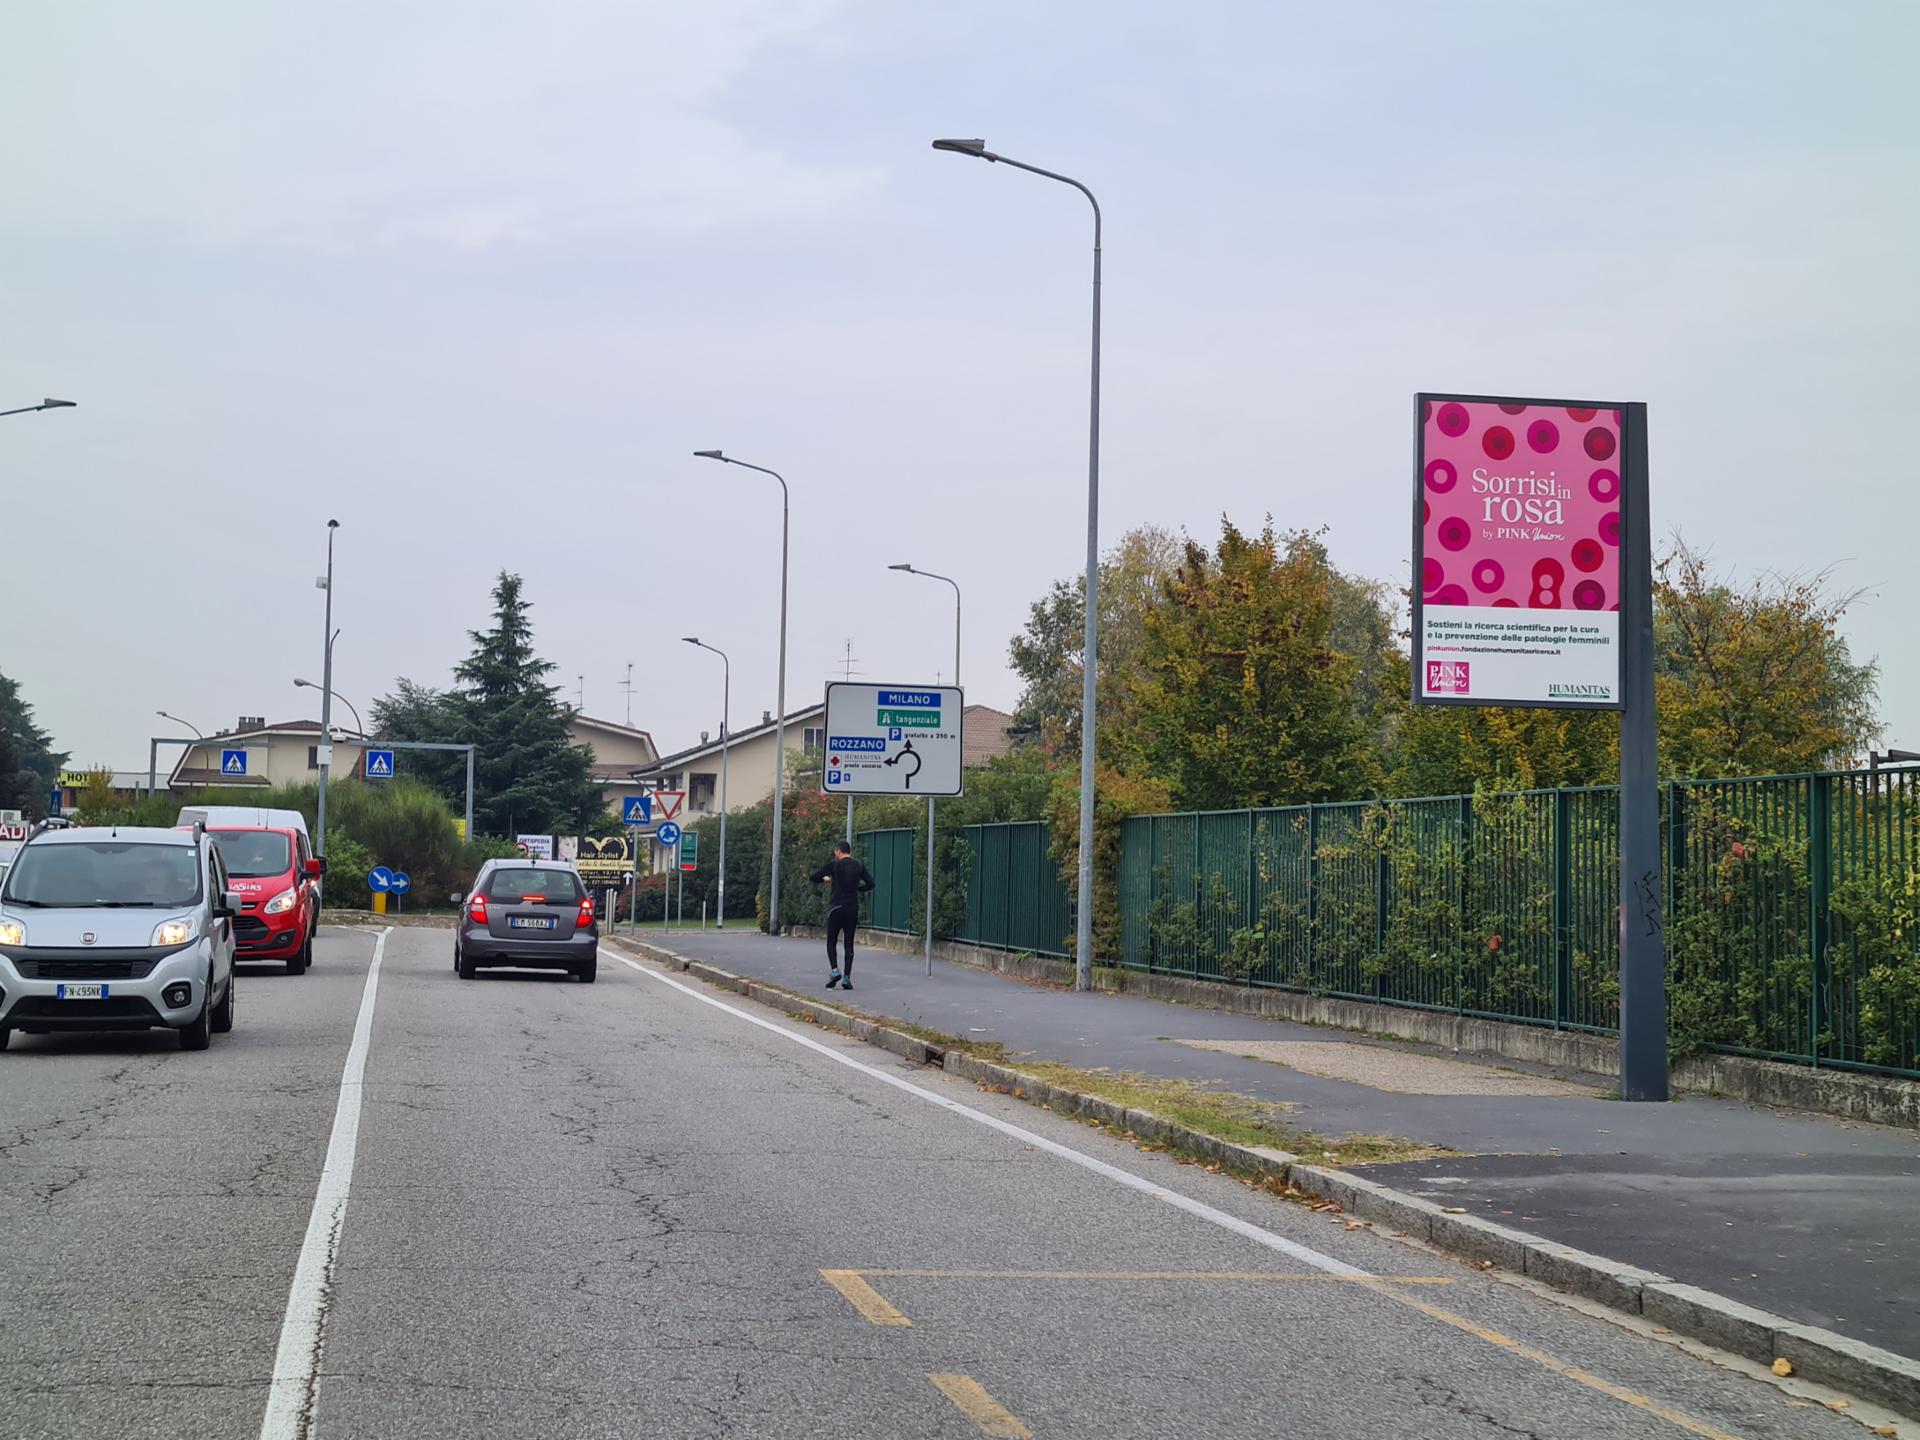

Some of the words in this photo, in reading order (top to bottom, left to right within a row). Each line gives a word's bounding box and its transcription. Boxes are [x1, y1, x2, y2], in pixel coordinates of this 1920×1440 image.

[1471, 467, 1556, 496] Sorrisi
[1557, 484, 1571, 499] in
[1482, 496, 1565, 525] rosa
[1482, 528, 1493, 540] by
[1497, 527, 1530, 539] PINK
[1531, 527, 1565, 541] Union
[1427, 620, 1463, 629] Sostieni
[1464, 621, 1472, 629] la
[1474, 622, 1504, 630] ricerca
[1506, 623, 1551, 632] scientifica
[1435, 631, 1442, 639] la
[1444, 632, 1499, 641] prevenzione
[1524, 635, 1567, 644] patologie
[1568, 636, 1610, 645] femminili
[1430, 665, 1467, 678] PINK
[1549, 683, 1611, 694] HUMANITAS
[888, 694, 930, 705] MILANO
[895, 714, 938, 725] tangenziale
[891, 729, 900, 739] P
[831, 739, 884, 749] ROZZANO
[830, 772, 839, 782] P
[597, 851, 619, 859] Stylist
